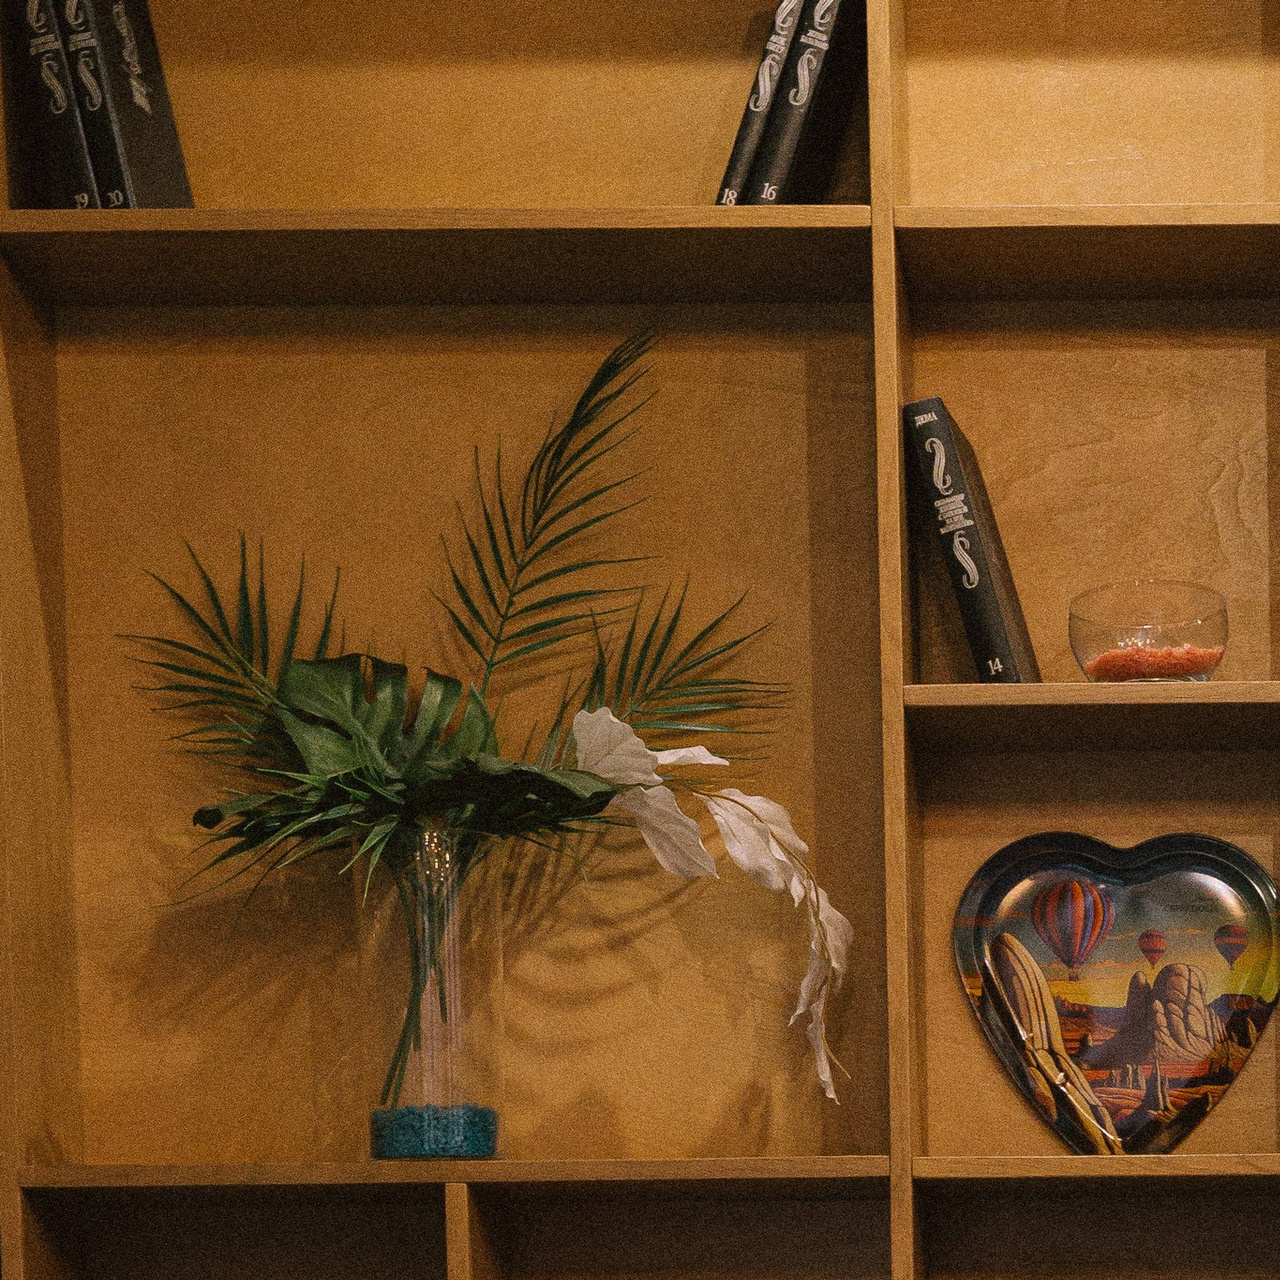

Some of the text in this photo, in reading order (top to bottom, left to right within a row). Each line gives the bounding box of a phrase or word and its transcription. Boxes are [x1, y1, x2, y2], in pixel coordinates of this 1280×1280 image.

[721, 188, 737, 206] 18
[761, 183, 777, 200] 16
[988, 658, 1003, 675] 14
